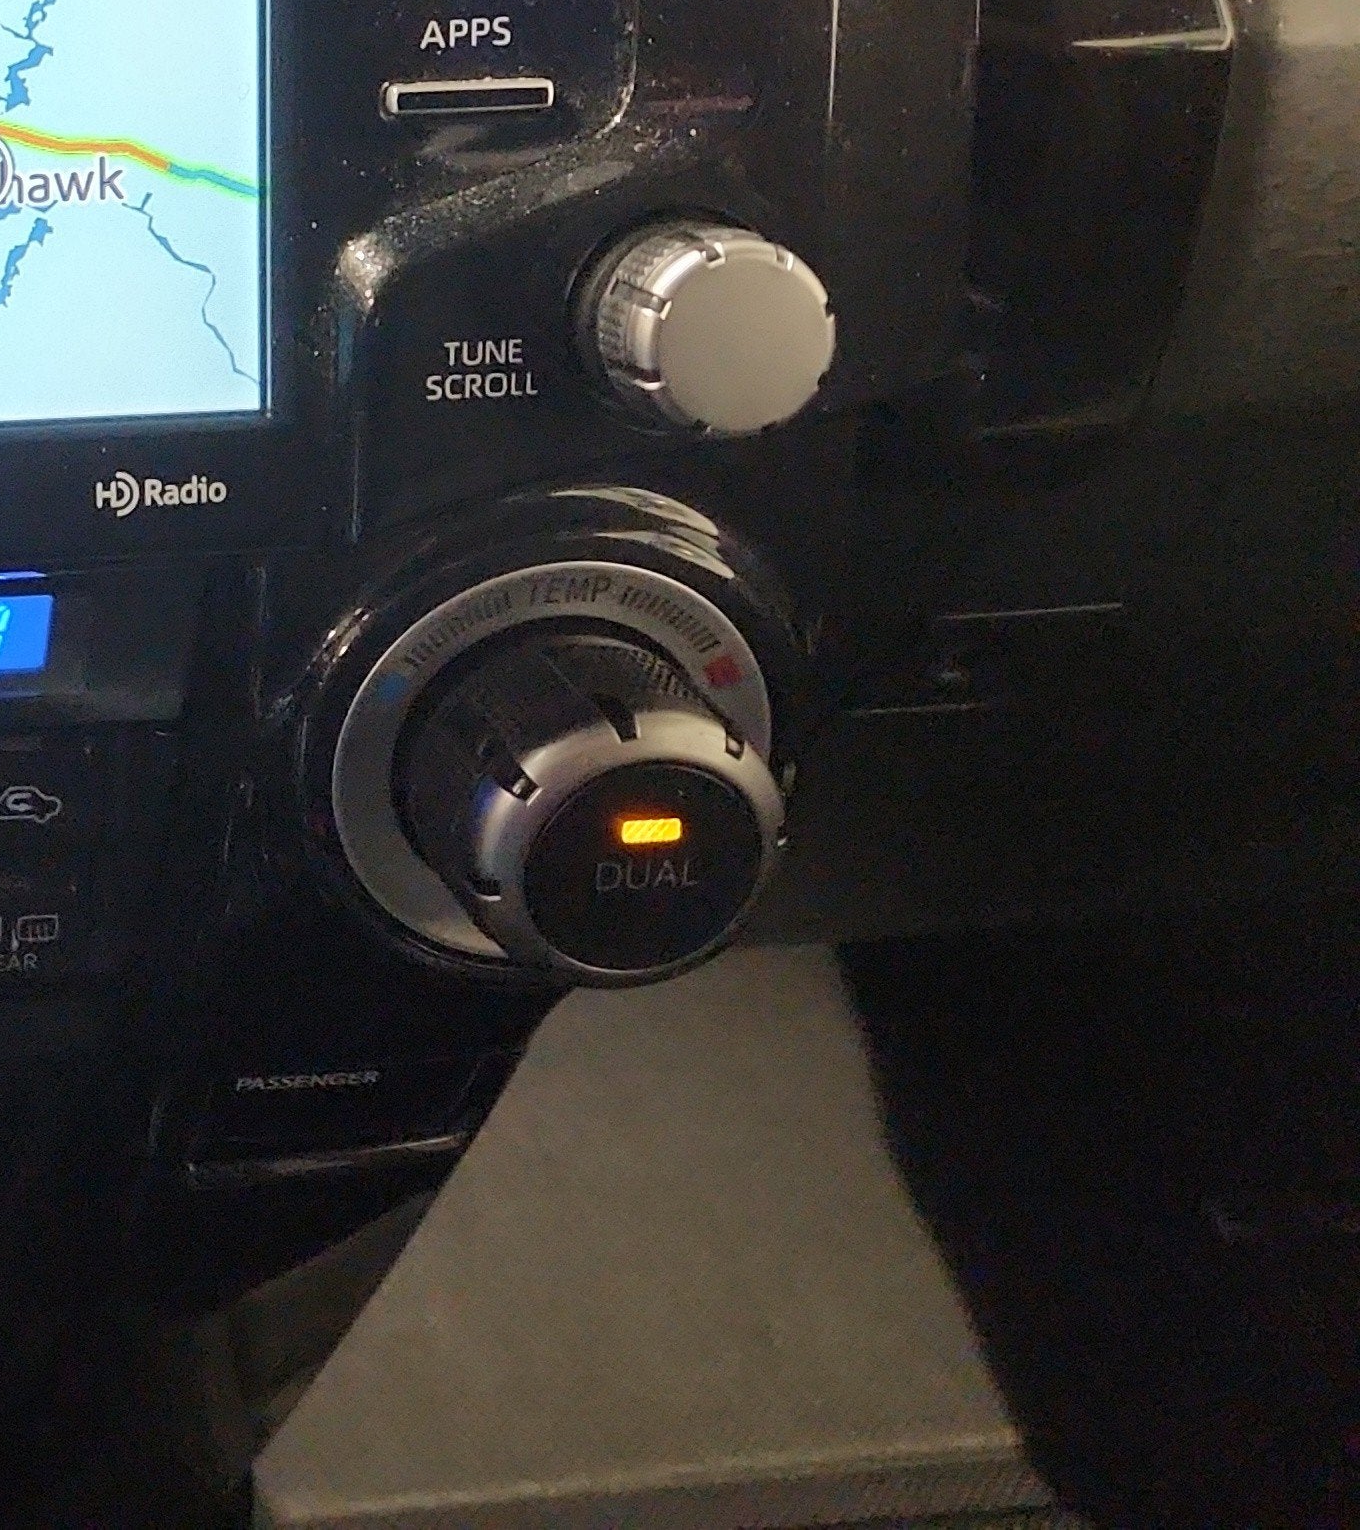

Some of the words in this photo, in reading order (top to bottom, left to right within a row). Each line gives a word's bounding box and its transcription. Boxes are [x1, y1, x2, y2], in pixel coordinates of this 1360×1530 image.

[420, 16, 511, 49] APPS
[445, 338, 523, 368] TUNE
[425, 371, 538, 401] SCROLL
[144, 474, 227, 507] Radio
[523, 575, 611, 605] TEMP
[595, 858, 698, 892] DUAL
[235, 1070, 380, 1092] PASSENGER
